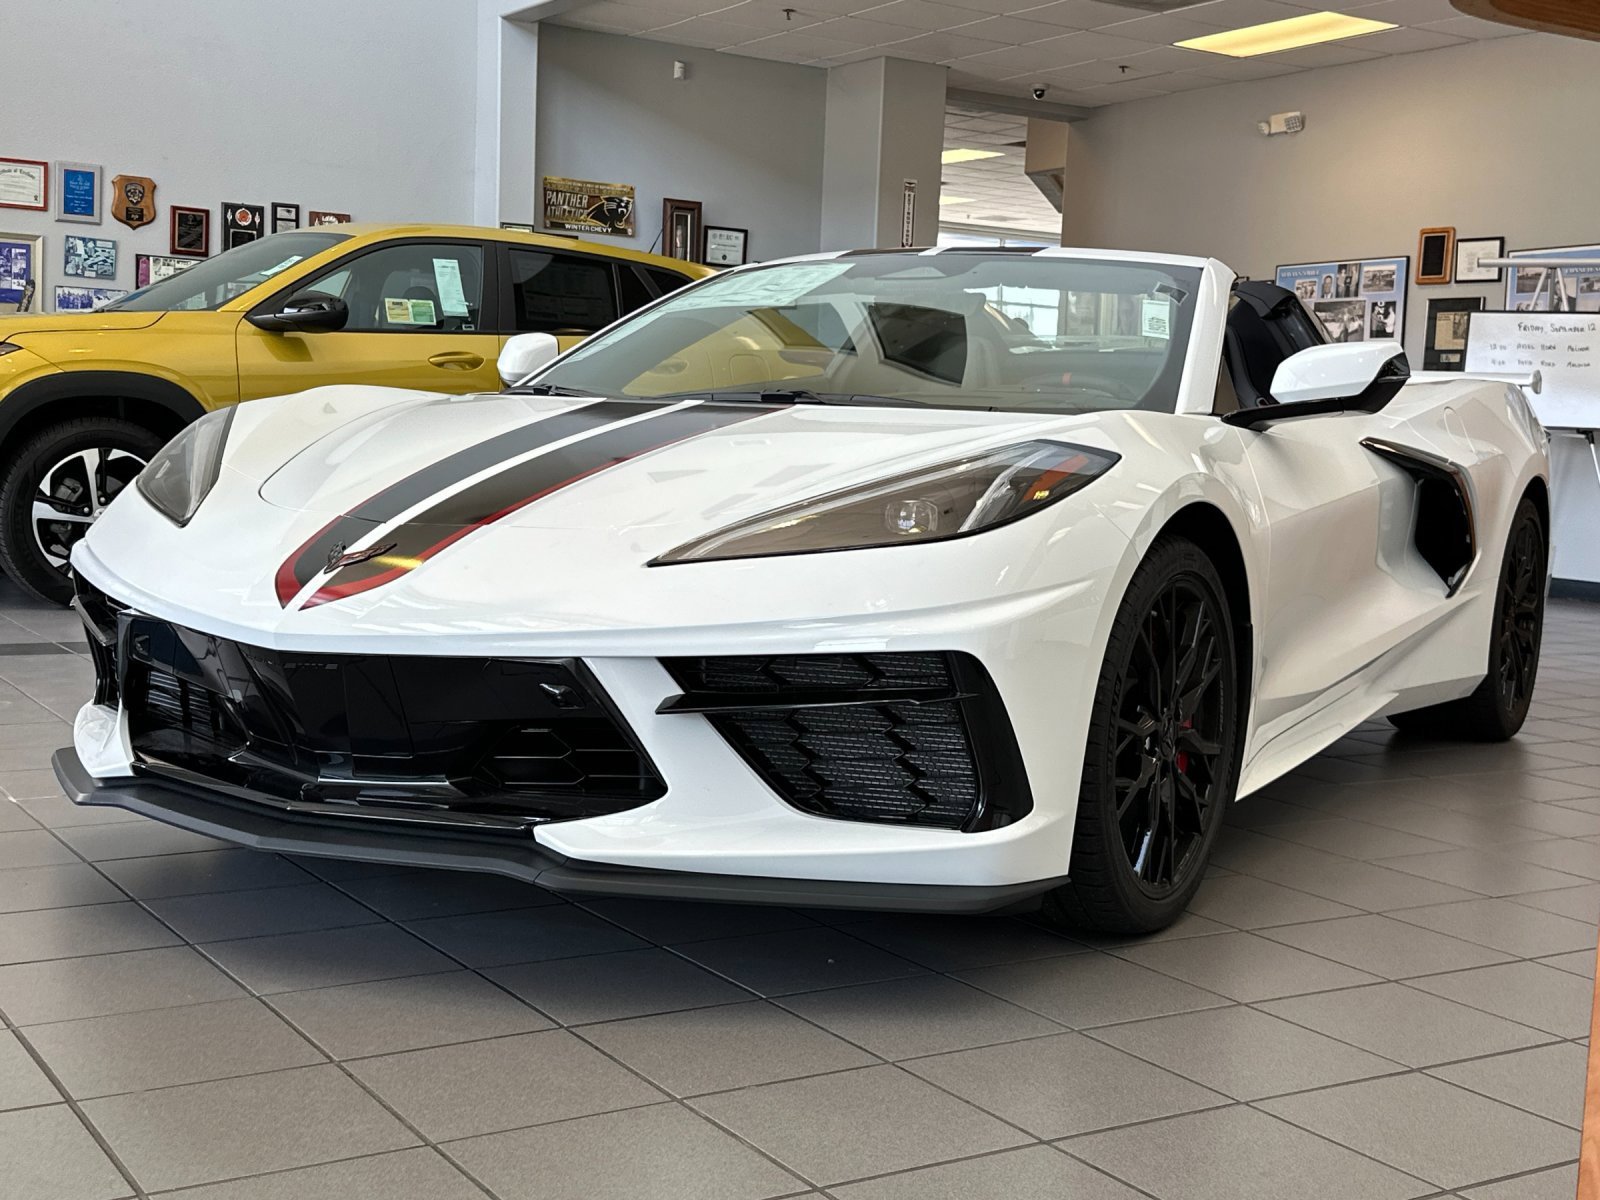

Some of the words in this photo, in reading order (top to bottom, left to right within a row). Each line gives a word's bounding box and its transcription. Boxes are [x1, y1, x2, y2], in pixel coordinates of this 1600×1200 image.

[545, 190, 589, 209] PANTHER
[564, 223, 590, 231] WINTER
[590, 225, 612, 233] CHEVY
